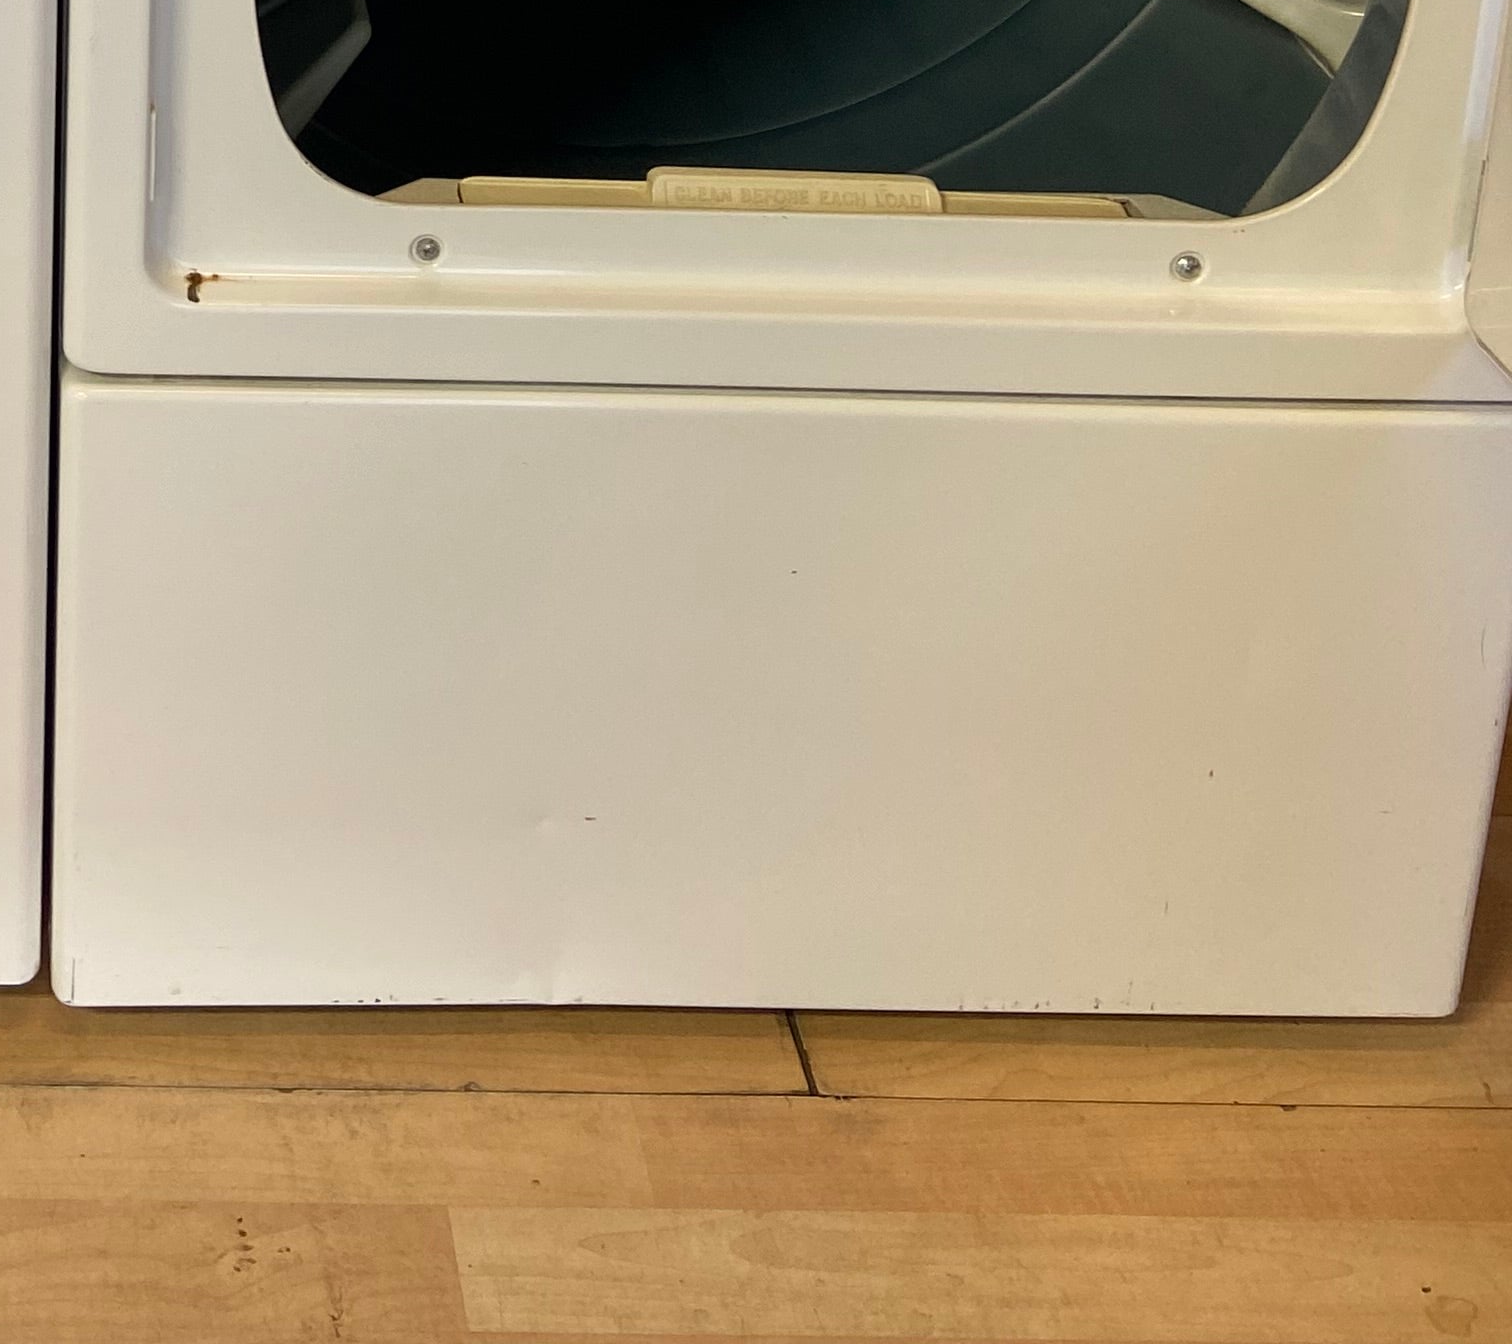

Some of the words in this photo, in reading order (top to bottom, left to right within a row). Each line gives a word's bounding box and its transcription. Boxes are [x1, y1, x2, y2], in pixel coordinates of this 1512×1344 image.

[674, 186, 732, 203] CLEAN
[741, 188, 809, 205] BEFORE
[819, 190, 866, 208] EACH
[875, 192, 923, 209] LOAD
